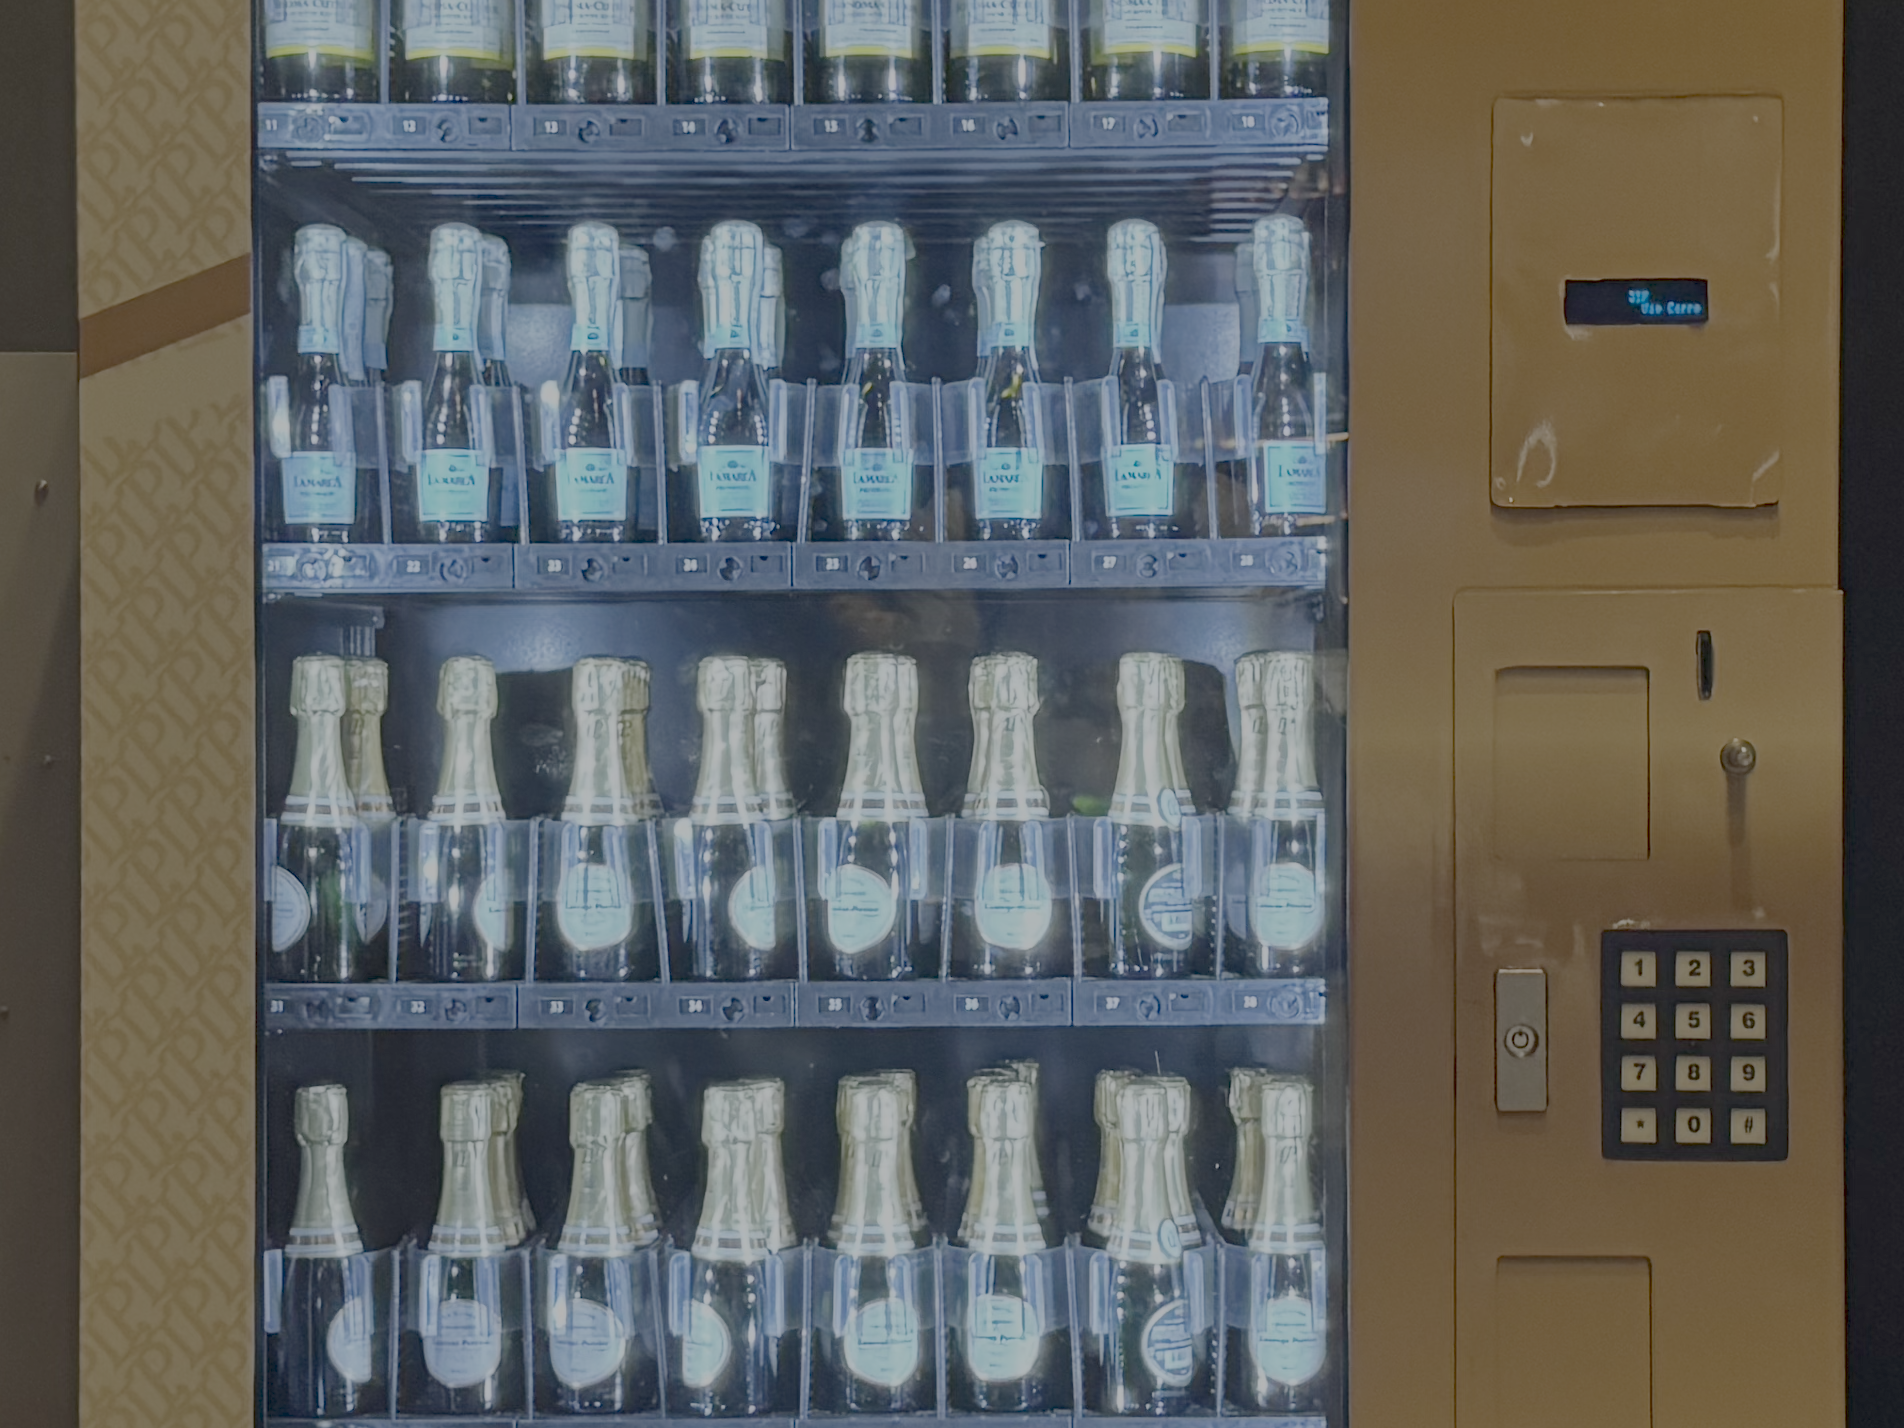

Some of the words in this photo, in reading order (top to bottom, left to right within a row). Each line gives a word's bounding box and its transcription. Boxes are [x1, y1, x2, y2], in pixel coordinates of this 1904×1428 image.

[265, 119, 278, 131] 11
[1102, 117, 1116, 130] 17
[1634, 958, 1643, 977] 1
[1688, 958, 1702, 977] 2
[1742, 958, 1756, 977] 3
[1632, 1010, 1646, 1028] 4
[1688, 1010, 1701, 1029] 5
[1742, 1011, 1756, 1029] 6
[1633, 1062, 1647, 1081] 7
[1687, 1063, 1701, 1081] 8
[1742, 1063, 1756, 1082] 9
[1687, 1115, 1701, 1134] 0
